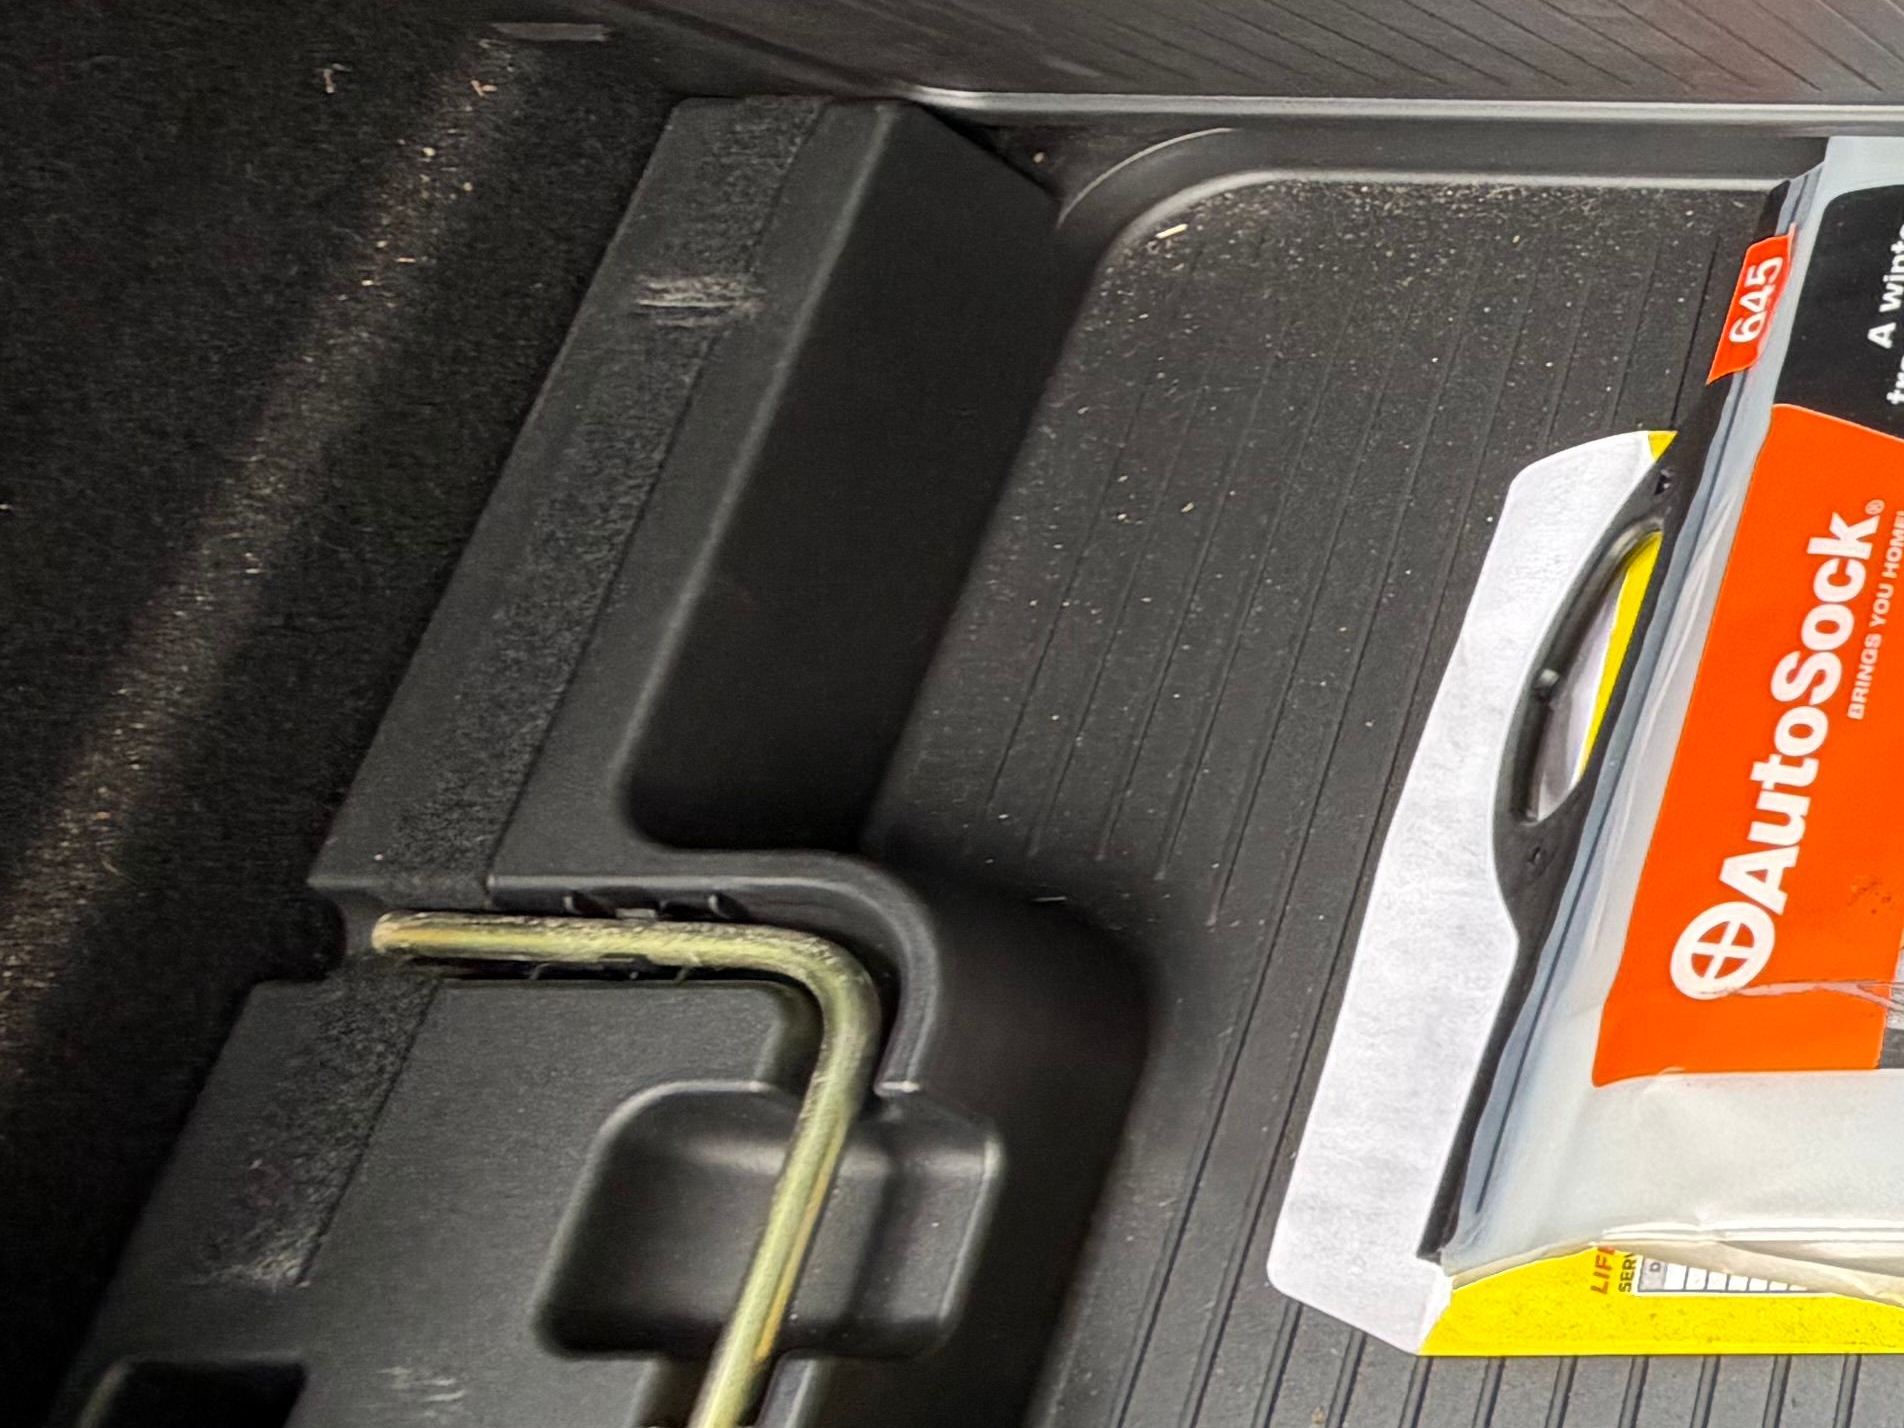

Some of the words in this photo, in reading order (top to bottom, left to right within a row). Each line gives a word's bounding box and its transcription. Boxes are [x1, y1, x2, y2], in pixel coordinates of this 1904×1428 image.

[1727, 256, 1783, 343] 645
[1866, 321, 1897, 349] A
[1846, 632, 1882, 720] BRINGS
[1868, 582, 1894, 627] YOU
